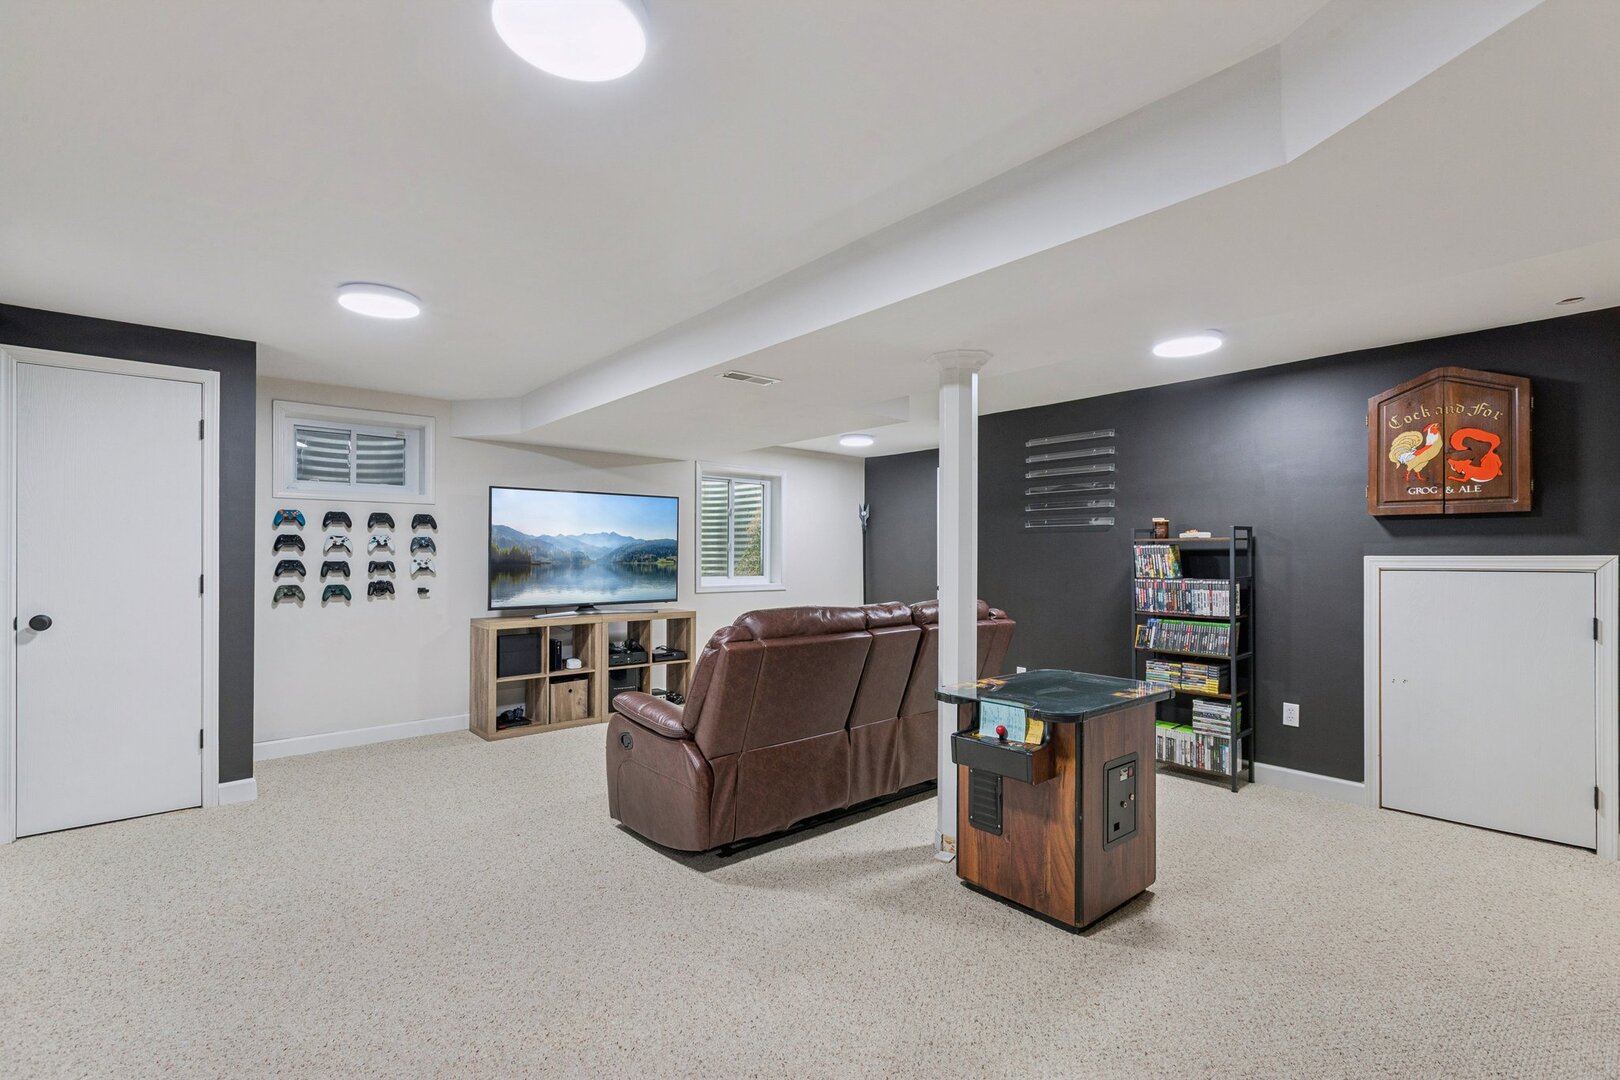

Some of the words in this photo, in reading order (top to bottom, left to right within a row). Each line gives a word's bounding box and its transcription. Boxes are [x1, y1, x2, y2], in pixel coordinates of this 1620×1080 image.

[1388, 404, 1430, 428] Cock
[1434, 404, 1465, 415] and
[1408, 486, 1438, 495] GROG
[1445, 486, 1454, 494] &
[1458, 485, 1482, 493] ALE
